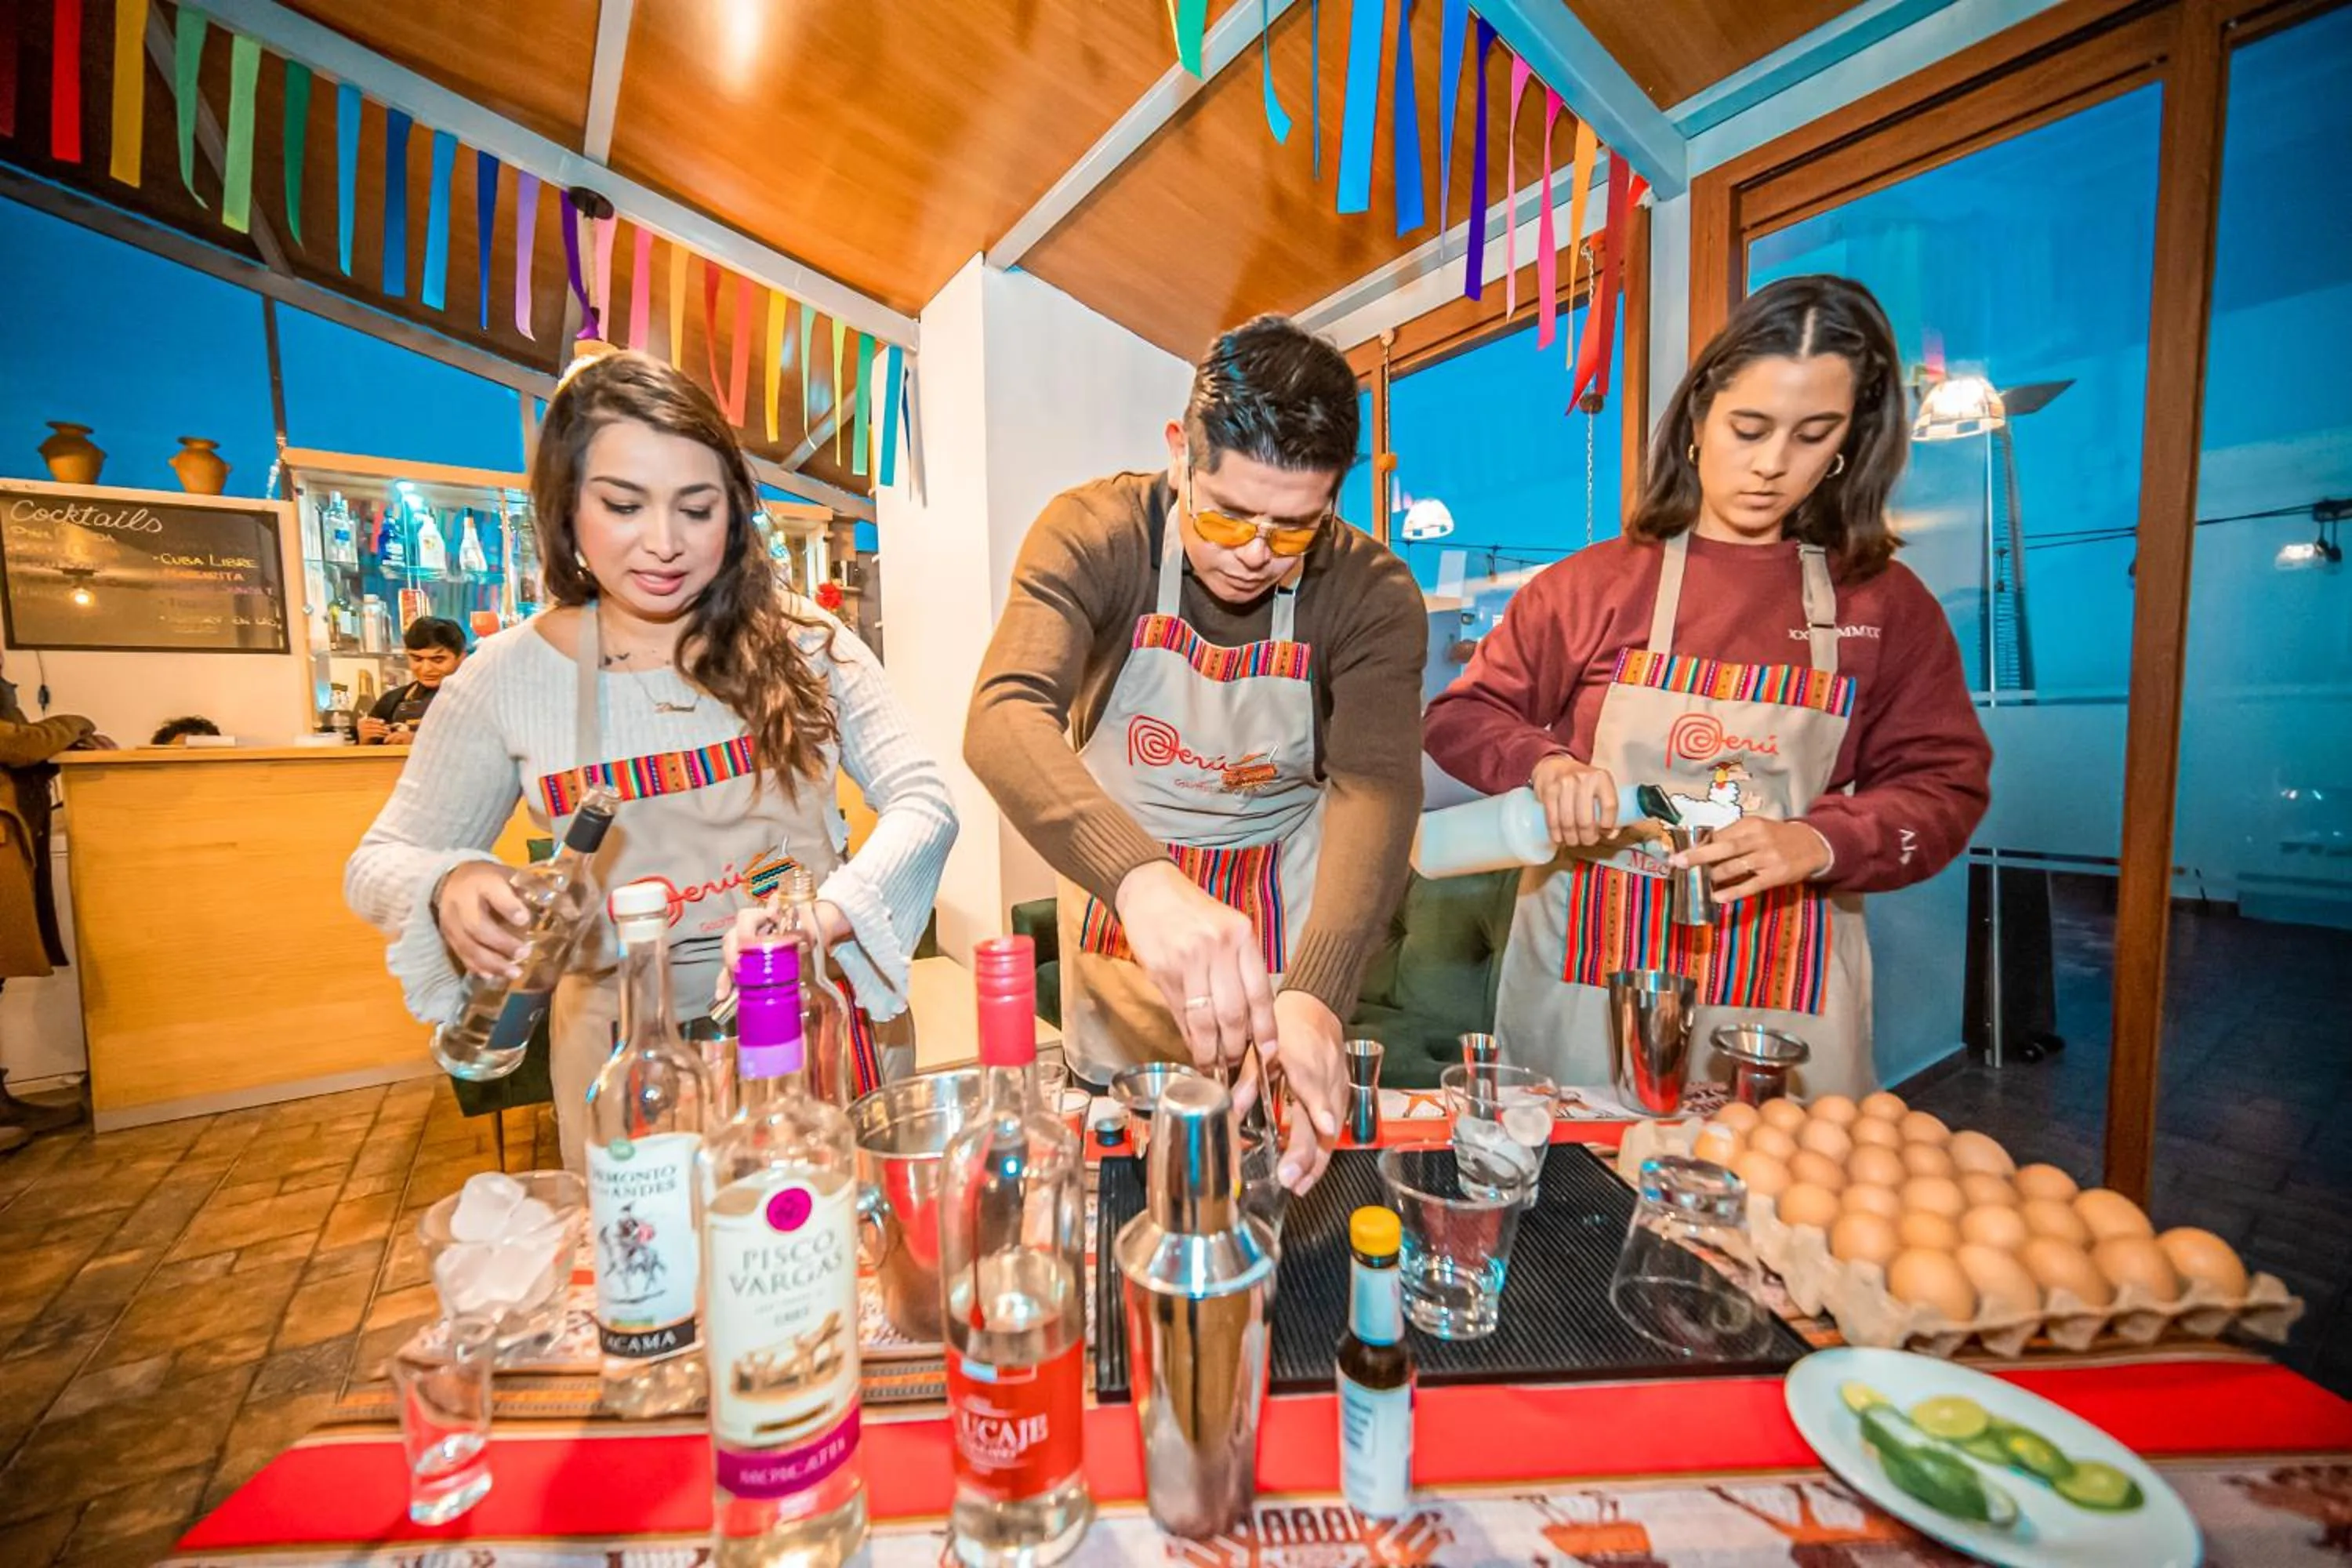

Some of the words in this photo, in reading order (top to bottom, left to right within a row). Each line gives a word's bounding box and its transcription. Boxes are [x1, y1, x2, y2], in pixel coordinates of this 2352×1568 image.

[10, 499, 163, 533] Cocktails
[209, 554, 260, 569] LIBRE
[1665, 712, 1780, 770] Perú
[742, 1229, 836, 1270] PISCO
[728, 1244, 843, 1297] VARGAS
